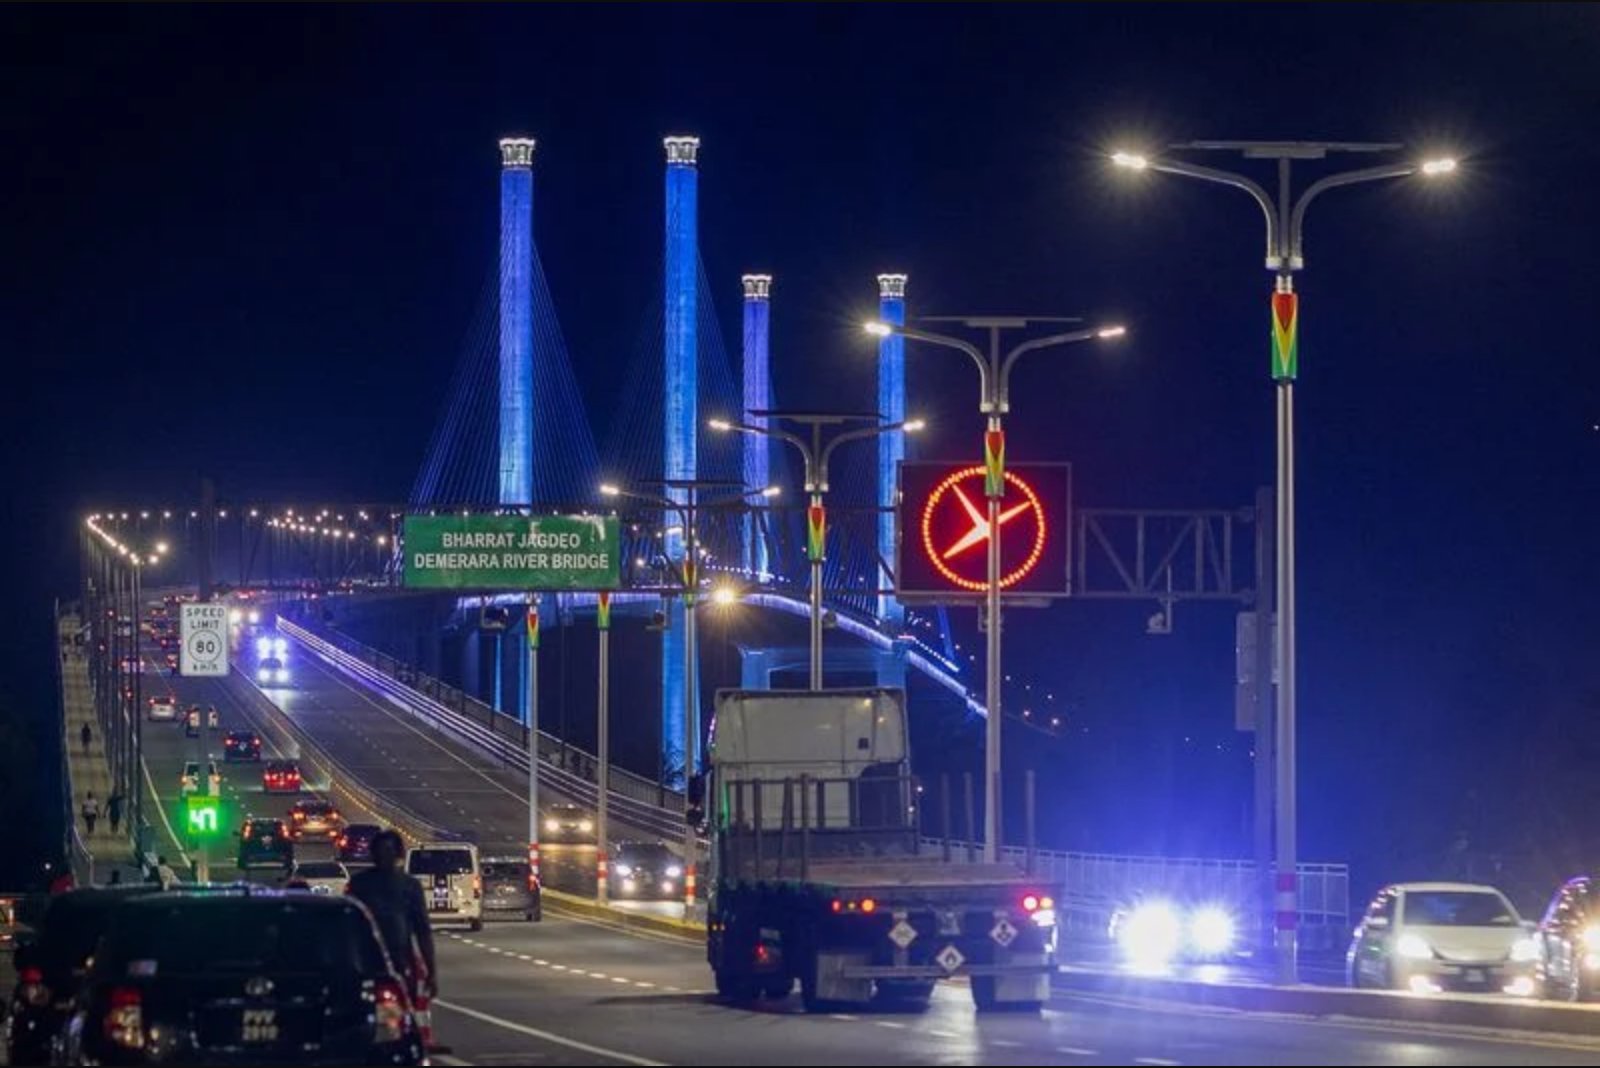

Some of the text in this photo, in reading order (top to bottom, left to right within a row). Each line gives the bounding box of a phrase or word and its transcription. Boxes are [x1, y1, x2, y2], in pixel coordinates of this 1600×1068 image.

[442, 531, 581, 548] BHARRAT JAGDEO
[414, 553, 609, 569] DEMERARA RIVER BRIDGE
[186, 607, 225, 618] SPEED
[190, 619, 219, 630] LIMIT
[196, 640, 216, 654] 80
